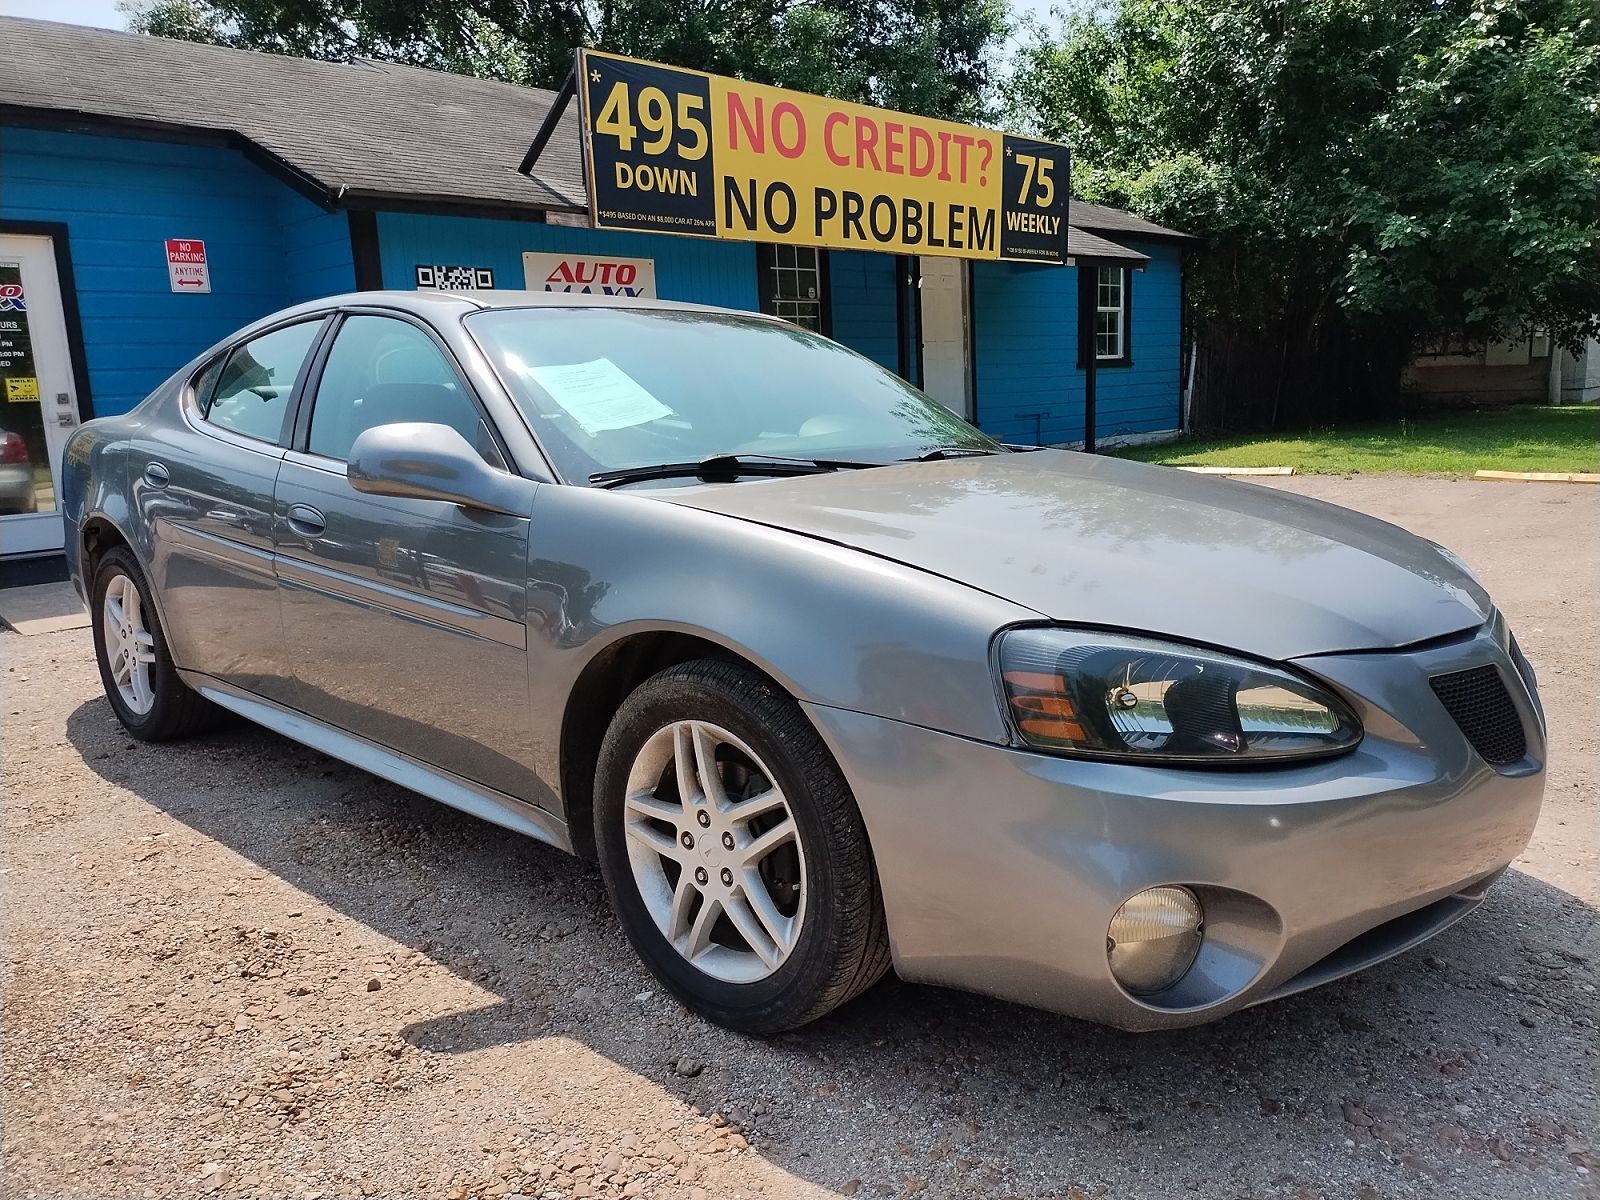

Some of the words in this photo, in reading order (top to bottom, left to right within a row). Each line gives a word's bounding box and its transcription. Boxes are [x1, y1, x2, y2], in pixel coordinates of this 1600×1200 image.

[727, 91, 807, 160] NO
[823, 111, 993, 187] CREDIT?
[615, 161, 698, 197] DOWN
[617, 212, 637, 220] BASED
[637, 213, 647, 221] ON
[647, 214, 656, 222] AN
[675, 217, 686, 225] CAR
[723, 175, 797, 234] NO
[814, 186, 996, 252] PROBLEM
[1006, 211, 1061, 235] WEEKLY
[170, 252, 204, 261] PARKING
[179, 242, 191, 252] NO
[175, 267, 203, 276] ANYTIME
[545, 261, 637, 285] AUTO
